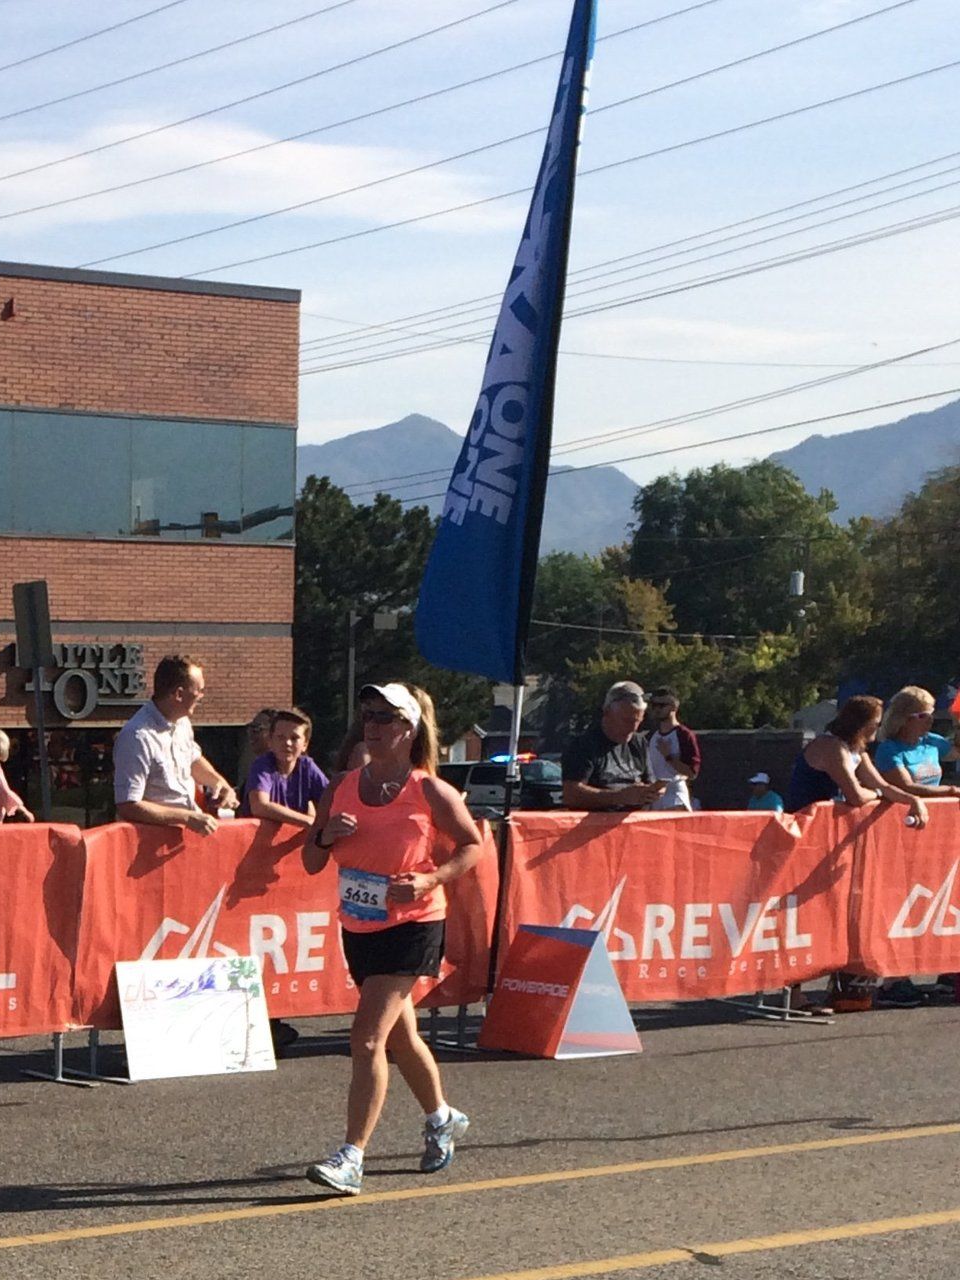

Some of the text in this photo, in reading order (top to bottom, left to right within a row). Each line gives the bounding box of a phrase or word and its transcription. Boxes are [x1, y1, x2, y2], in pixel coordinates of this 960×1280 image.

[468, 384, 527, 525] ONE
[54, 668, 146, 720] ONE
[344, 887, 378, 905] 5635
[641, 894, 812, 960] REVEL
[638, 953, 813, 979] Race Series
[271, 977, 318, 995] ace
[501, 978, 570, 998] POWERADE
